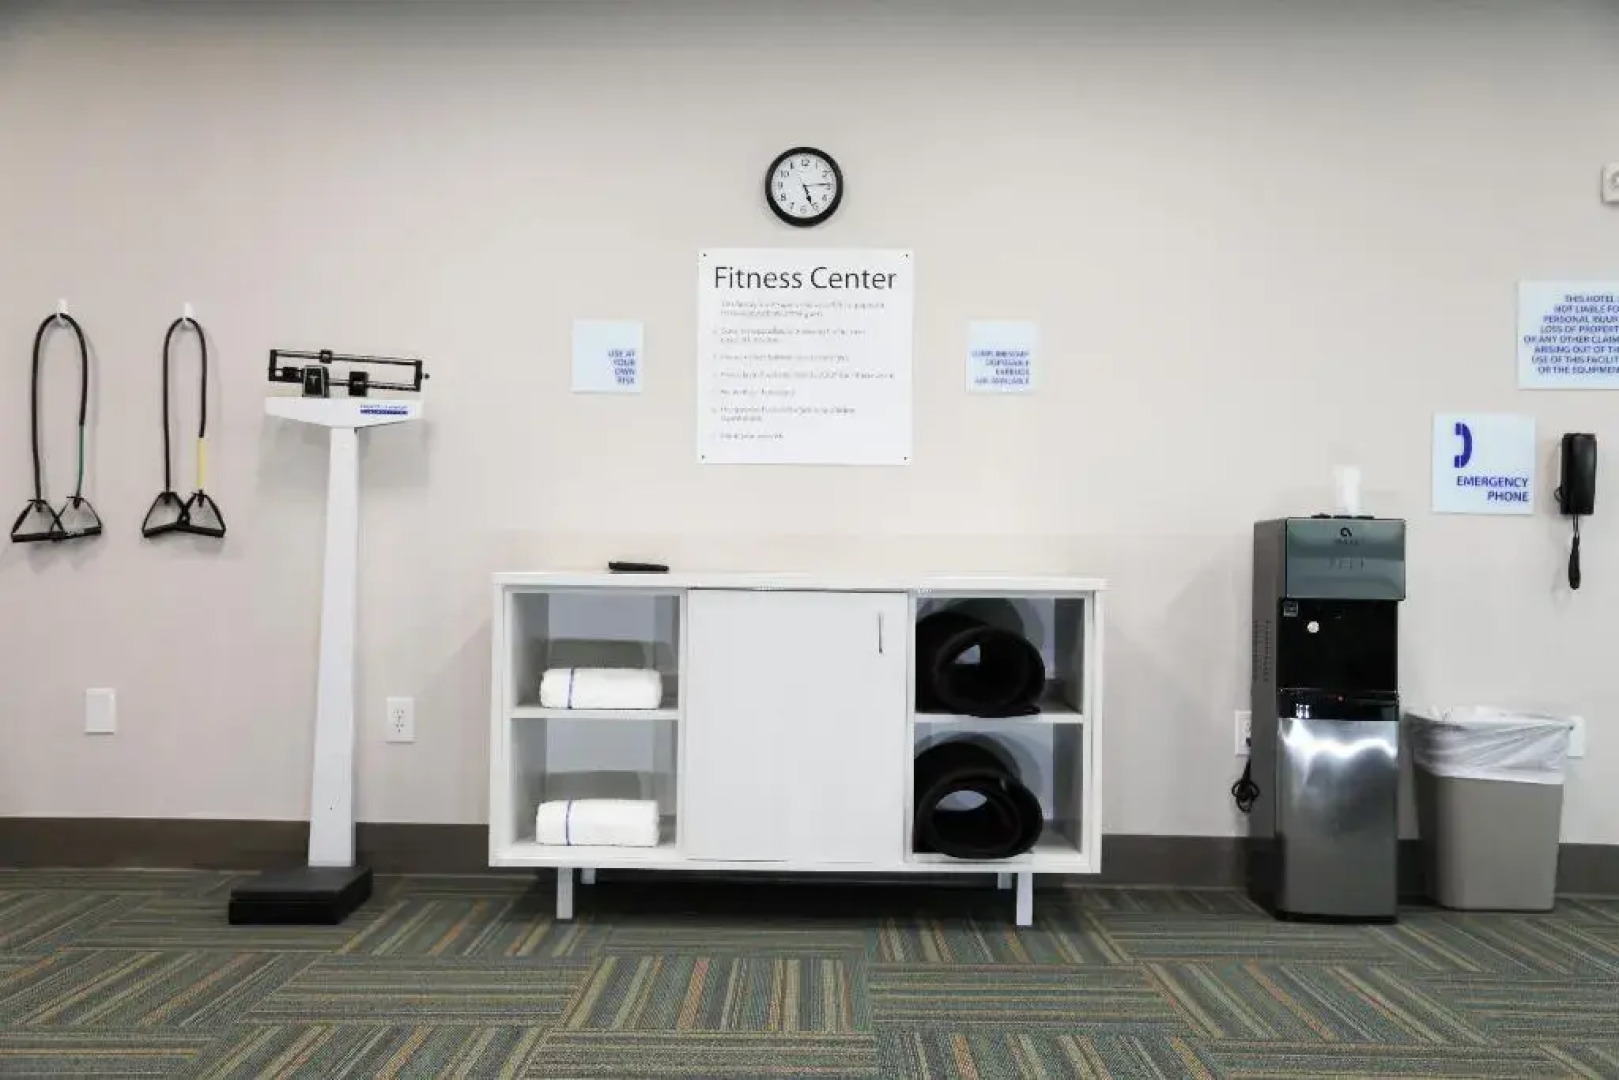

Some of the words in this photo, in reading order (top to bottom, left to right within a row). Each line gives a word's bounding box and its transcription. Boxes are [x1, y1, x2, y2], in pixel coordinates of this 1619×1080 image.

[714, 266, 803, 289] Fitness
[810, 266, 897, 289] Center
[1564, 294, 1584, 302] THIS
[1586, 294, 1613, 302] HOTEL
[1553, 304, 1573, 313] NOT
[1575, 304, 1605, 313] LIABLE
[1543, 315, 1589, 323] PERSONAL
[1540, 325, 1562, 333] LOSS
[1539, 335, 1557, 343] ANY
[1560, 335, 1590, 343] OTHER
[608, 349, 624, 357] USE
[1535, 345, 1570, 353] ARISING
[1572, 345, 1591, 353] OUT
[1593, 345, 1606, 353] OF
[1531, 355, 1548, 363] USE
[1565, 355, 1585, 363] THIS
[614, 368, 635, 376] OWN
[1553, 366, 1569, 374] THE
[617, 377, 635, 385] RISK
[1456, 475, 1528, 488] EMERGENCY
[1487, 491, 1529, 502] PHONE
